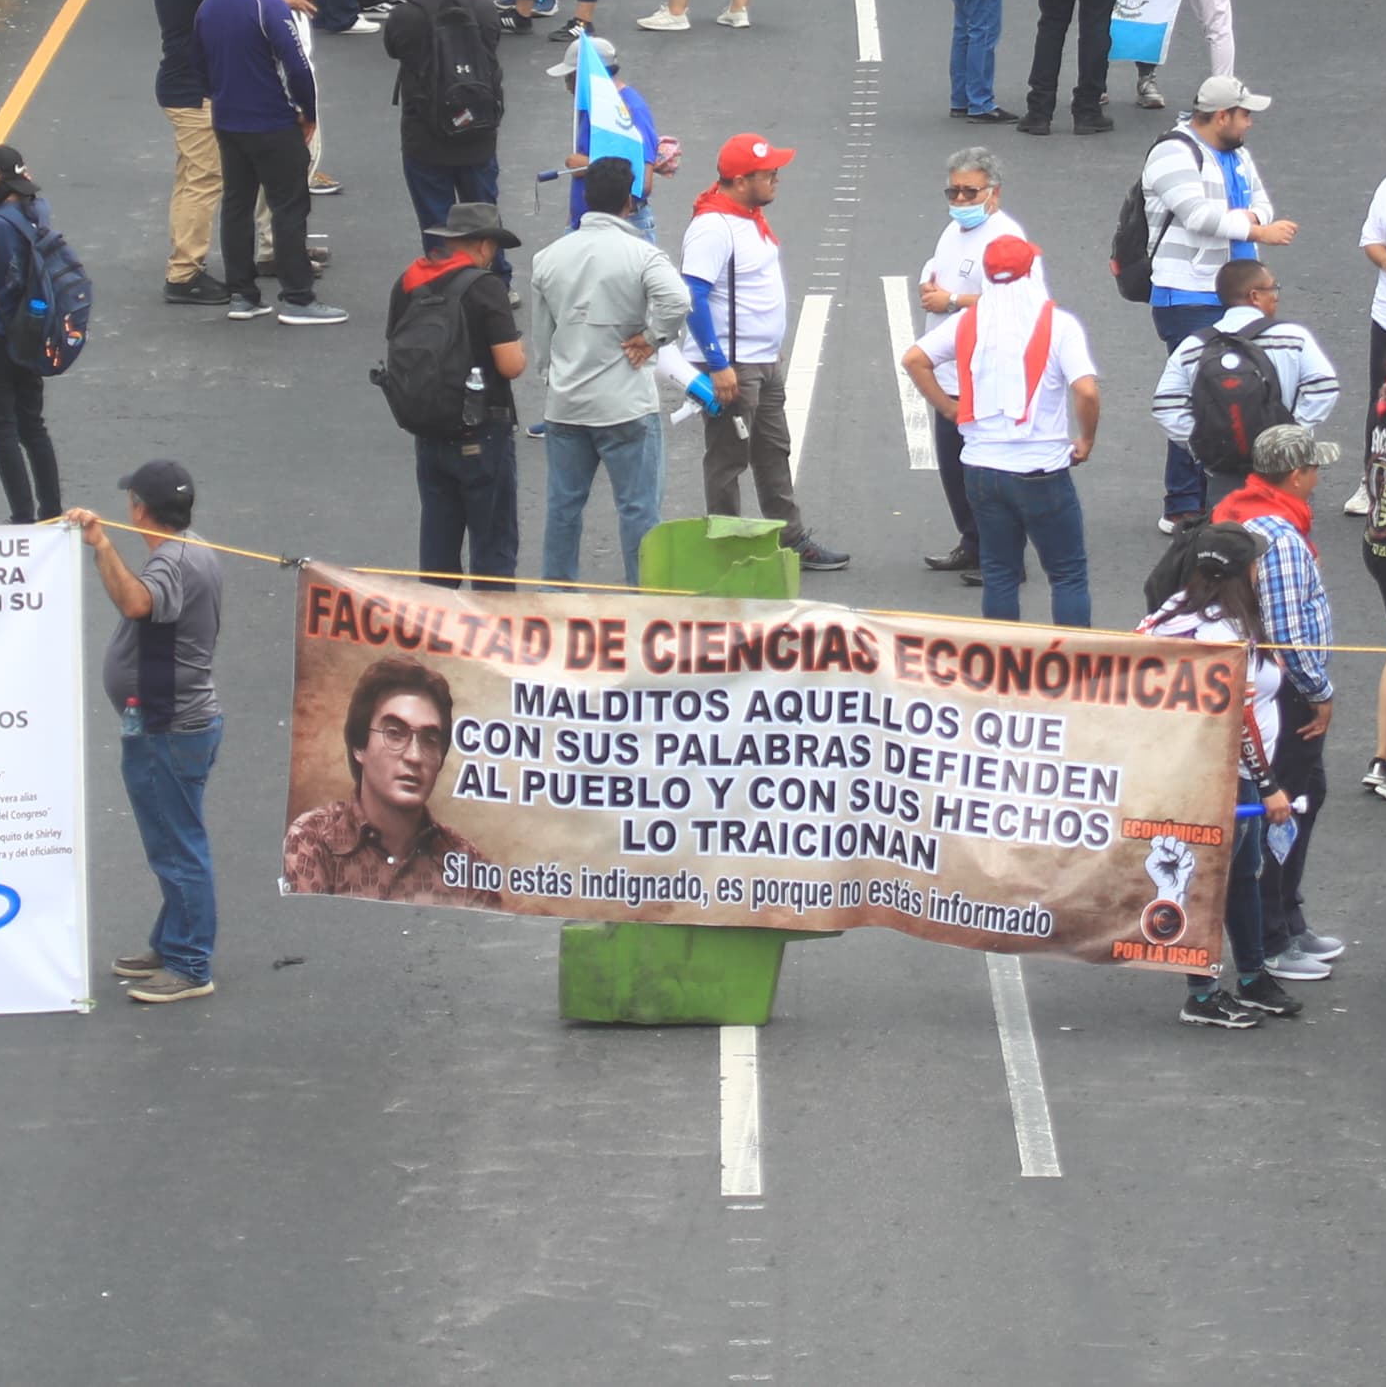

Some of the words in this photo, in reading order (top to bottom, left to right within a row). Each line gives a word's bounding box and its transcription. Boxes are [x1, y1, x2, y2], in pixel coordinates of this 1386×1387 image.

[10, 592, 44, 611] SU
[307, 583, 551, 666] FACULTAD
[564, 617, 627, 673] DE
[642, 619, 878, 675] CIENCIAS
[894, 634, 1233, 715] ECONÓMICAS
[514, 682, 730, 723] MALDITOS
[744, 689, 960, 740] AQUELLOS
[975, 712, 1064, 755] QUE
[454, 718, 542, 761] CON
[555, 729, 640, 768] SUS
[655, 731, 872, 769] PALABRAS
[884, 741, 1121, 806] DEFIENDEN
[454, 763, 509, 802] AL
[522, 770, 692, 811] PUEBLO
[707, 776, 733, 811] Y
[748, 777, 837, 814] CON
[848, 777, 921, 825] SUS
[933, 794, 1111, 850] HECHOS
[1122, 818, 1223, 846] ECONÓMICAS
[621, 818, 677, 855] LO
[692, 820, 938, 873] TRAICIONAN
[444, 852, 468, 887] Si
[473, 862, 502, 891] no
[509, 863, 573, 897] estás
[580, 865, 710, 909] indignado,
[716, 876, 743, 903] es
[750, 878, 833, 913] porque
[839, 877, 862, 907] no
[867, 875, 923, 915] estás
[928, 889, 1053, 939] informado
[1113, 941, 1144, 960] POR
[1146, 943, 1163, 962] LA
[1167, 946, 1209, 966] USAC
